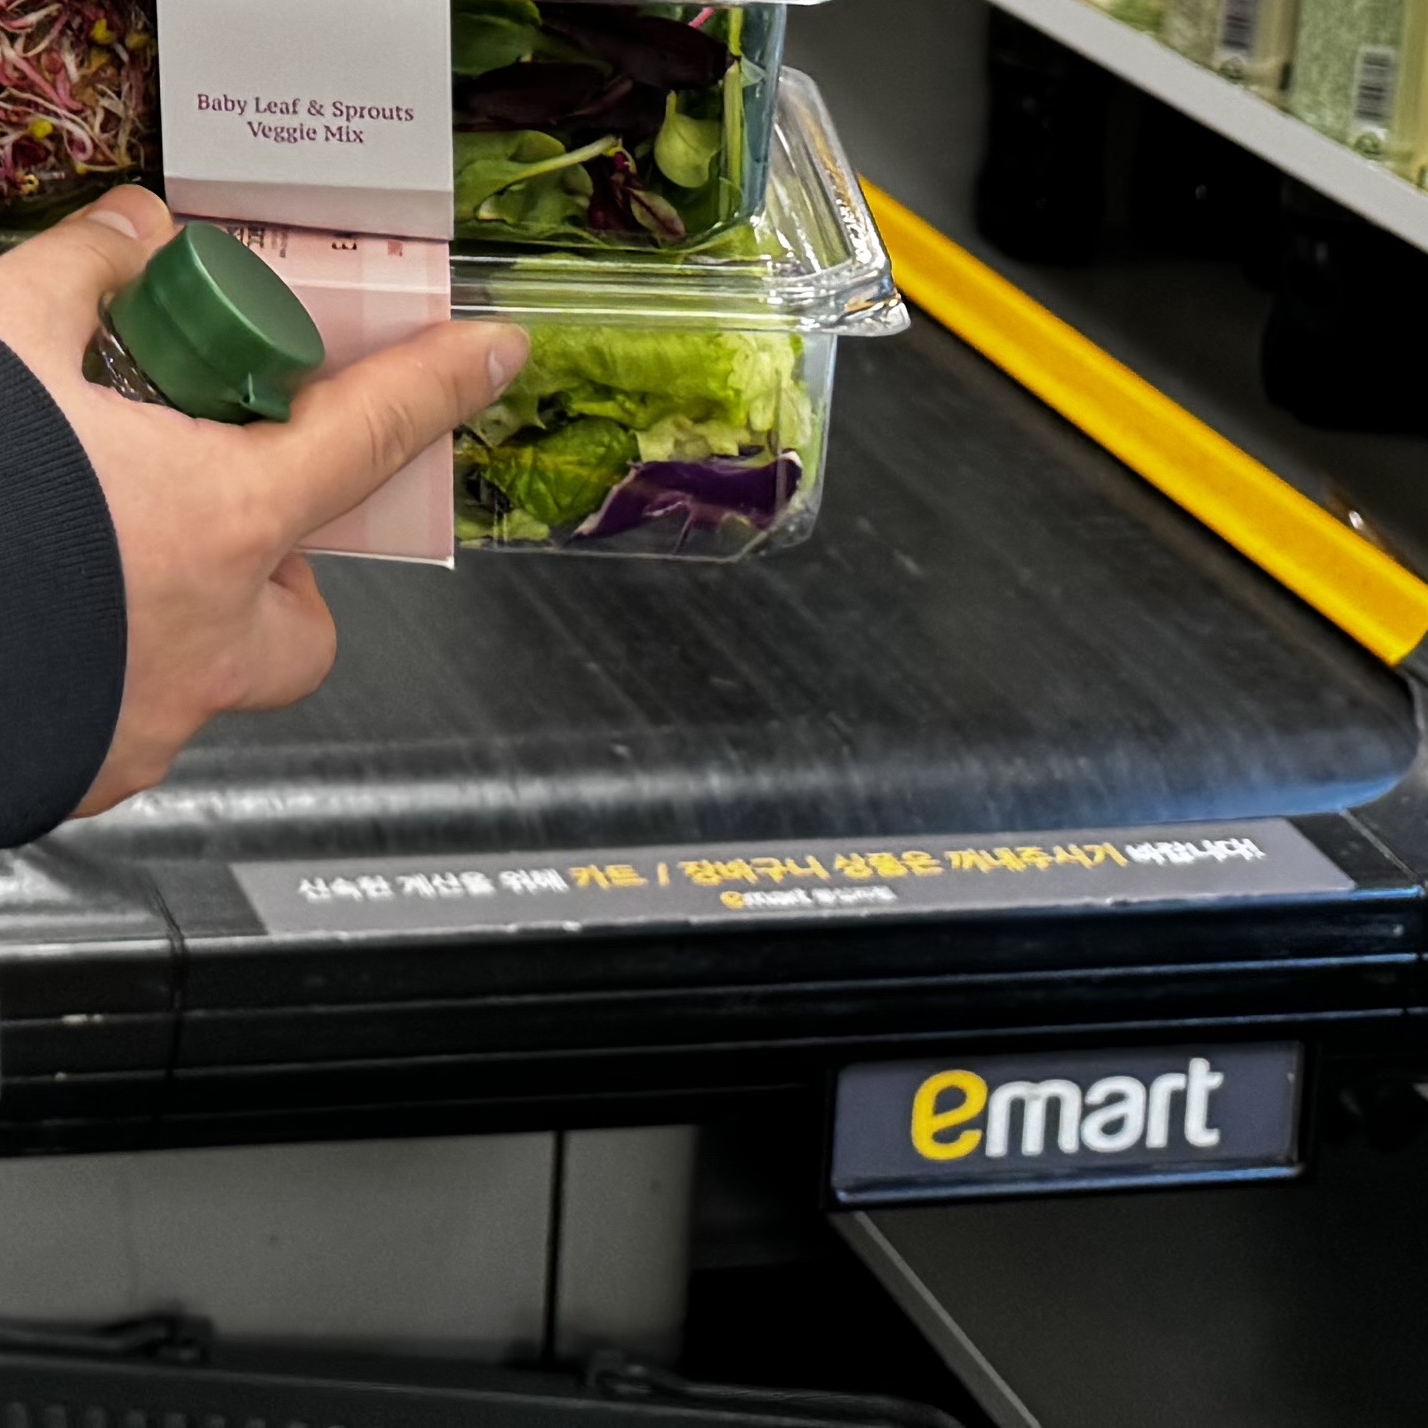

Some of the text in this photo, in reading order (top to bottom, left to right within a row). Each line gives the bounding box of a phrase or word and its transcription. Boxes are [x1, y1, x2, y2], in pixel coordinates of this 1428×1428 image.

[197, 94, 414, 122] Baby Leaf & Sprouts
[247, 121, 365, 144] Veggie Mix
[298, 875, 395, 904] 신속한
[396, 869, 496, 899] 계산을
[498, 866, 571, 894] 위해
[568, 862, 648, 891] 카트
[678, 855, 831, 886] 장바구니
[834, 849, 943, 881] 상품은
[946, 841, 1130, 873] 꺼내주시기
[911, 1057, 1224, 1161] emart
